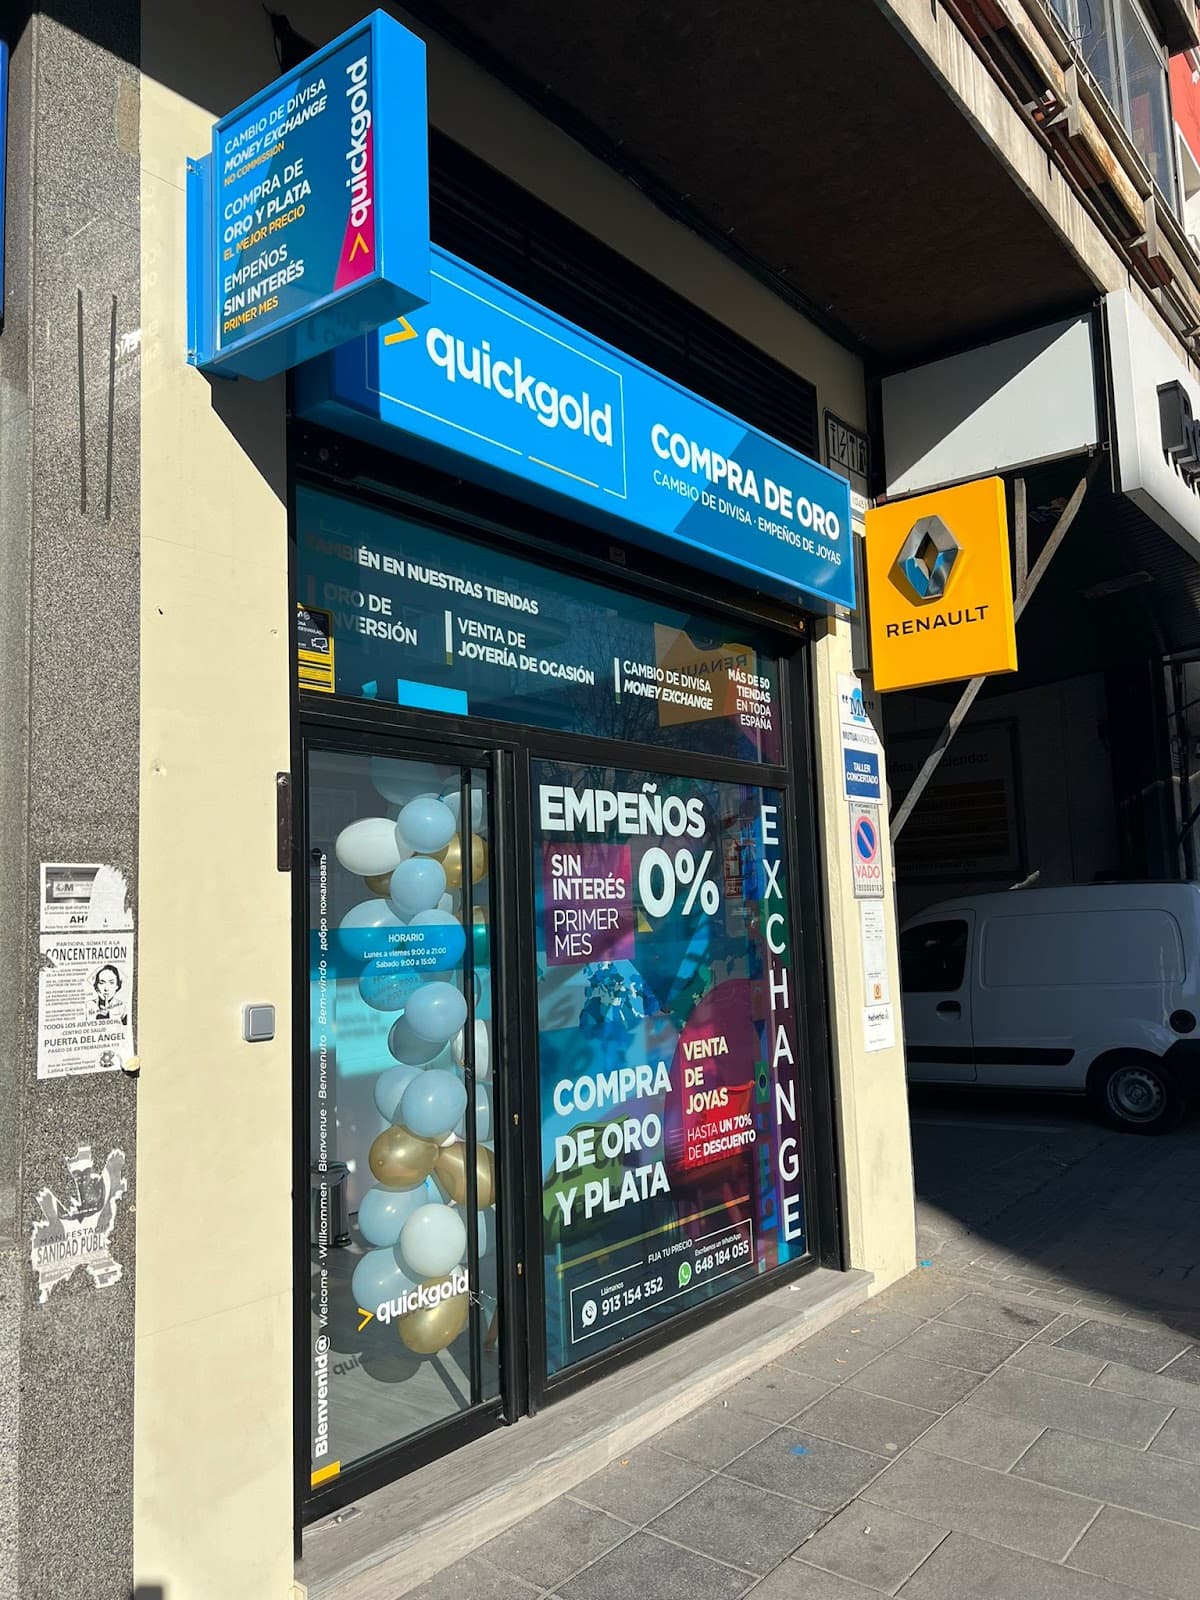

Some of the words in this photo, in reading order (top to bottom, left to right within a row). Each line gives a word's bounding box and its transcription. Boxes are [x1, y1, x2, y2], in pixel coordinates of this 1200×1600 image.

[224, 144, 263, 175] MONEY
[264, 95, 328, 149] EXCHANGE
[225, 117, 267, 154] CAMBIO
[270, 102, 285, 127] DE
[287, 78, 326, 110] DIVISA
[346, 55, 372, 227] quickgold
[224, 174, 236, 186] NO
[238, 141, 285, 180] COMMISSION
[224, 176, 280, 220] COMPRA
[285, 159, 304, 185] DE
[224, 218, 252, 243] ORO
[255, 209, 265, 226] Y
[267, 179, 311, 219] PLATA
[224, 249, 235, 261] EL
[236, 227, 267, 252] MEJOR
[269, 204, 305, 232] PRECIO
[224, 243, 287, 292] EMPEÑOS
[224, 291, 245, 316] SIN
[248, 259, 304, 306] INTERÉS
[224, 308, 257, 334] PRIMER
[259, 295, 278, 314] MES
[426, 327, 613, 447] quickgold
[651, 423, 760, 504] COMPRA
[764, 478, 793, 520] DE
[797, 497, 840, 540] ORO
[653, 470, 699, 501] CAMBIO
[702, 491, 716, 510] DE
[719, 498, 752, 526] DIVISA
[758, 518, 801, 548] EMPEÑOS
[803, 538, 815, 554] DE
[816, 544, 841, 566] JOYAS
[368, 594, 392, 616] DE
[383, 556, 404, 577] EN
[408, 563, 482, 599] NUESTRAS
[484, 586, 539, 615] TIENDAS
[457, 617, 504, 643] VENTA
[508, 631, 526, 649] DE
[886, 606, 988, 638] RENAULT
[458, 641, 517, 669] JOYERÍA
[520, 658, 537, 674] DE
[540, 660, 595, 686] OCASIÓN
[623, 660, 664, 682] CAMBIO
[666, 670, 679, 685] DE
[681, 674, 712, 693] DIVISA
[728, 666, 747, 682] MÁS
[748, 674, 758, 687] DE
[760, 677, 770, 689] 50
[624, 679, 662, 699] MONEY
[662, 689, 713, 710] EXCHANGE
[737, 685, 771, 703] TIENDAS
[737, 699, 747, 711] EN
[750, 704, 772, 717] TODA
[741, 714, 772, 730] ESPAÑA
[847, 773, 879, 785] CONCERTADO
[853, 762, 871, 774] TALLER
[539, 782, 706, 838] EMPEÑOS
[551, 854, 581, 877] SIN
[639, 847, 720, 917] 0%
[553, 872, 626, 900] INTERÉS
[855, 864, 881, 879] VADO
[318, 918, 328, 950] добро
[388, 933, 424, 943] HORARIO
[554, 908, 619, 932] PRIMER
[555, 933, 592, 957] MES
[318, 960, 327, 1025] Bem-vindo
[44, 1038, 78, 1047] PUERTA
[81, 1036, 95, 1044] DEL
[683, 1036, 728, 1062] VENTA
[318, 1034, 328, 1099] Benvenuto
[685, 1066, 704, 1088] DE
[553, 1062, 673, 1116] COMPRA
[686, 1087, 729, 1115] JOYAS
[319, 1109, 328, 1172] Bienvenue
[554, 1128, 596, 1174] DE
[602, 1114, 661, 1159] ORO
[687, 1125, 718, 1143] HASTA
[719, 1119, 733, 1133] UN
[735, 1113, 752, 1128] 70%
[688, 1147, 701, 1161] DE
[703, 1129, 756, 1156] DESCUENTO
[556, 1187, 578, 1227] Y
[585, 1161, 670, 1219] PLATA
[319, 1178, 328, 1258] Willkommen
[37, 1239, 78, 1264] SANIDAD
[648, 1253, 661, 1264] FIJA
[662, 1249, 671, 1259] TU
[672, 1239, 692, 1254] PRECIO
[695, 1256, 713, 1274] 648
[715, 1249, 730, 1266] 184
[733, 1240, 749, 1258] 055
[319, 1269, 328, 1328] Welcome
[376, 1269, 469, 1324] quickgold
[602, 1293, 621, 1315] 913
[623, 1286, 641, 1306] 154
[644, 1276, 663, 1297] 352
[315, 1335, 330, 1458] Bienvenid@
